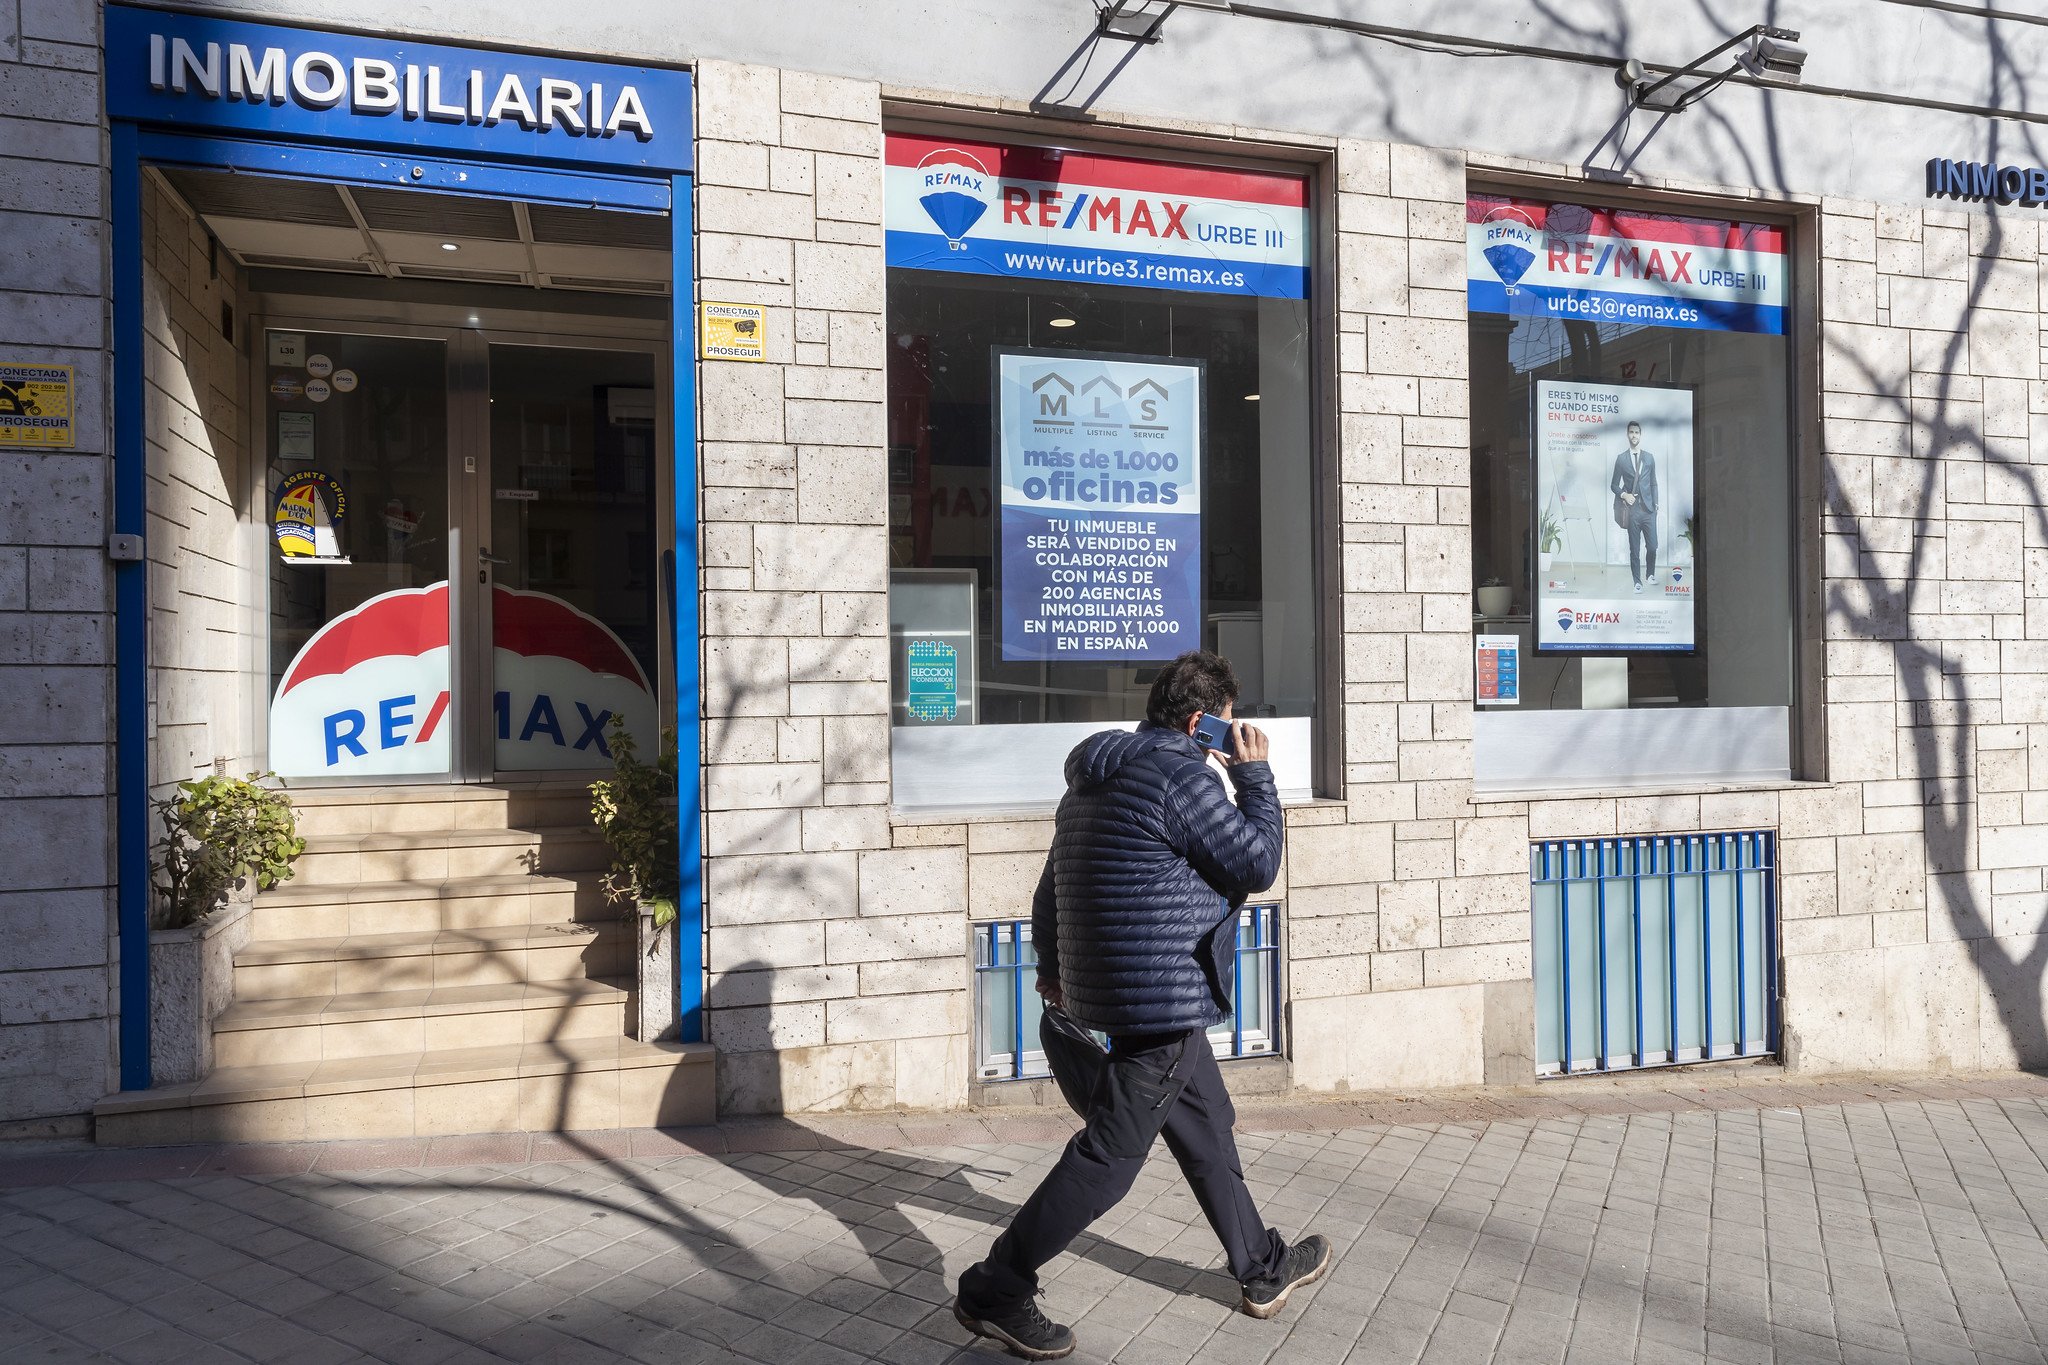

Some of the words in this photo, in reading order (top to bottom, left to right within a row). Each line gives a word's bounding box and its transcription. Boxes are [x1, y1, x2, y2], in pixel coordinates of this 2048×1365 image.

[150, 34, 653, 142] INMOBILIARIA
[925, 172, 983, 193] RE/MAX
[1003, 187, 1190, 241] RE/MAX
[1197, 222, 1258, 247] URBE
[1265, 229, 1284, 249] III
[1487, 227, 1533, 245] RE/MAX
[1005, 251, 1244, 288] www.urbe3.remax.es
[1547, 238, 1693, 284] RE/MAX
[1699, 269, 1746, 289] URBE
[1752, 273, 1766, 291] III
[707, 305, 760, 316] CONECTADA
[1548, 296, 1699, 322] urbe3@remax.es
[280, 347, 295, 355] L30
[707, 346, 761, 357] PROSEGUR
[309, 361, 329, 369] pisos
[307, 385, 328, 394] pisos
[1548, 390, 1572, 400] ERES
[1574, 390, 1586, 401] TÚ
[1589, 393, 1619, 403] MISMO
[1040, 393, 1067, 417] M
[1094, 396, 1110, 419] L
[1140, 399, 1157, 421] S
[1548, 402, 1589, 412] CUANDO
[1592, 403, 1619, 414] ESTÁS
[1548, 412, 1561, 421] EN
[1564, 413, 1576, 422] TU
[1578, 414, 1603, 424] CASA
[1034, 426, 1074, 435] MULTIPLE
[1087, 429, 1118, 437] LISTING
[1133, 431, 1165, 440] SERVICE
[1023, 446, 1075, 468] más
[1079, 448, 1110, 469] de
[1114, 450, 1179, 472] 1.000
[284, 472, 326, 488] AGENTE
[330, 481, 346, 519] OFICIAL
[1022, 471, 1178, 505] oficinas
[277, 529, 315, 541] VACACIONES
[1047, 519, 1069, 532] TU
[1074, 519, 1157, 535] INMUEBLE
[1026, 533, 1071, 549] SERÁ
[1075, 536, 1151, 551] VENDIDO
[1155, 538, 1176, 552] EN
[1035, 551, 1168, 568] COLABORACIÓN
[1051, 569, 1088, 583] CON
[1093, 568, 1127, 584] MÁS
[1132, 571, 1153, 584] DE
[1042, 586, 1075, 600] 200
[1079, 587, 1162, 601] AGENCIAS
[1040, 603, 1164, 617] INMOBILIARIAS
[1576, 612, 1620, 623] RE/MAX
[1024, 620, 1046, 633] EN
[1052, 620, 1117, 634] MADRID
[1121, 620, 1132, 633] Y
[1137, 620, 1179, 634] 1.000
[1057, 636, 1079, 650] EN
[1084, 634, 1149, 650] ESPAÑA
